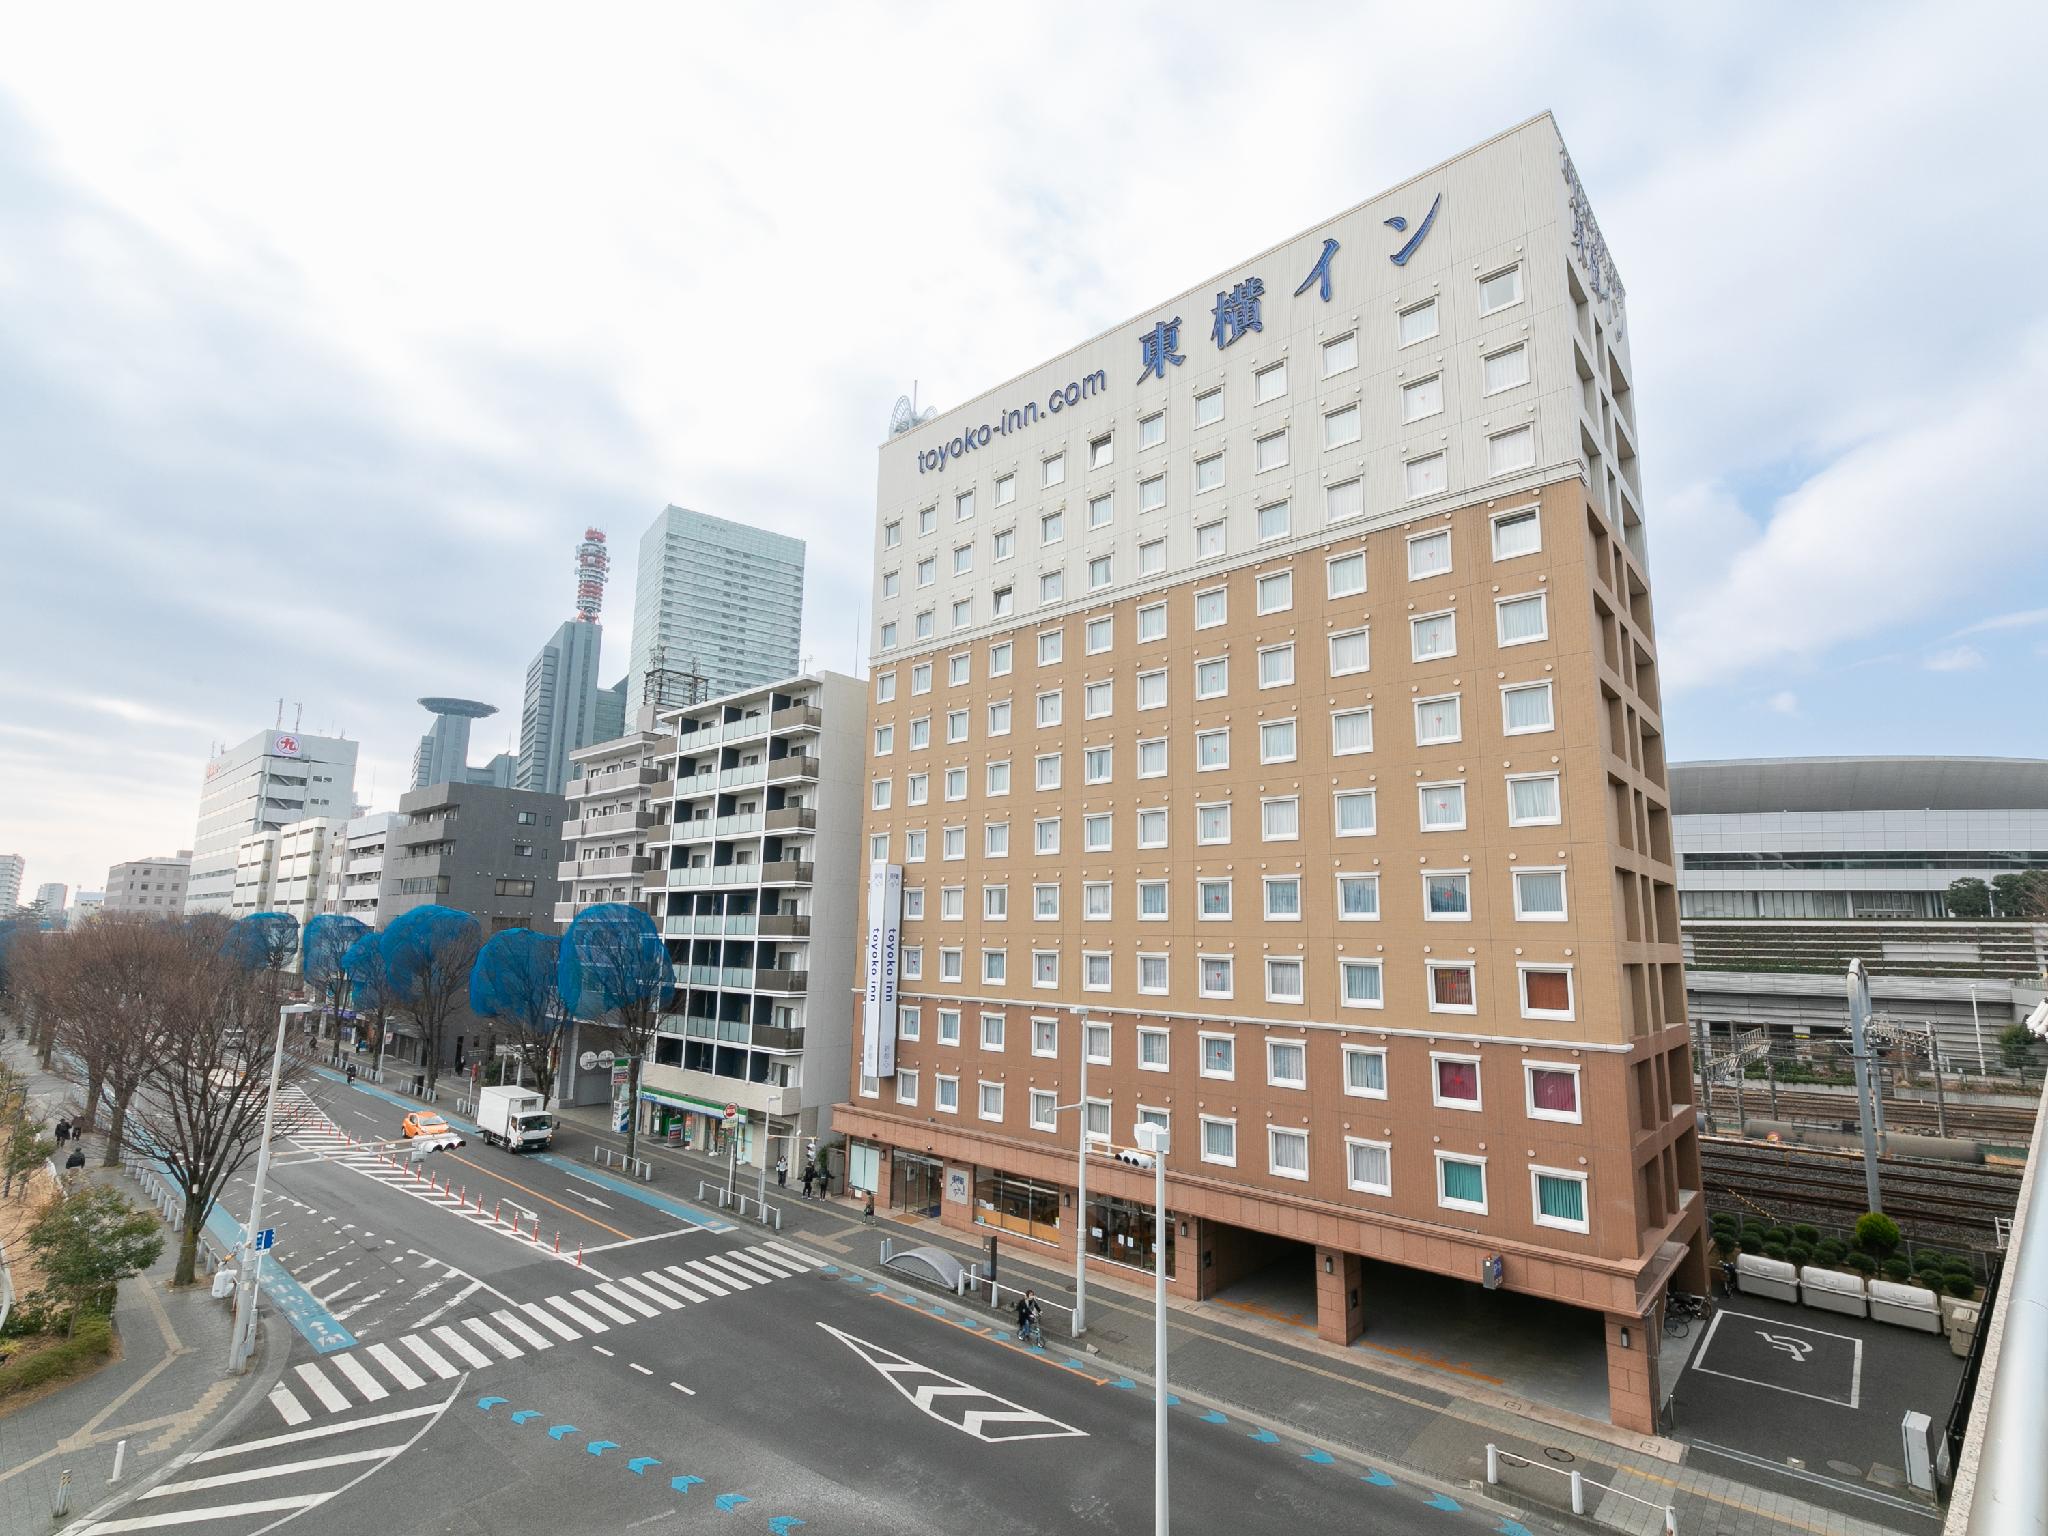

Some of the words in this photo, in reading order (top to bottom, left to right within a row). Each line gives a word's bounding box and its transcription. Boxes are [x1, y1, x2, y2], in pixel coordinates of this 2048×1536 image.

[918, 369, 1107, 474] toyoko-inn.com
[871, 927, 880, 976] toyoko
[886, 927, 897, 976] toyoko
[870, 980, 878, 1002] inn
[885, 980, 895, 1002] inn
